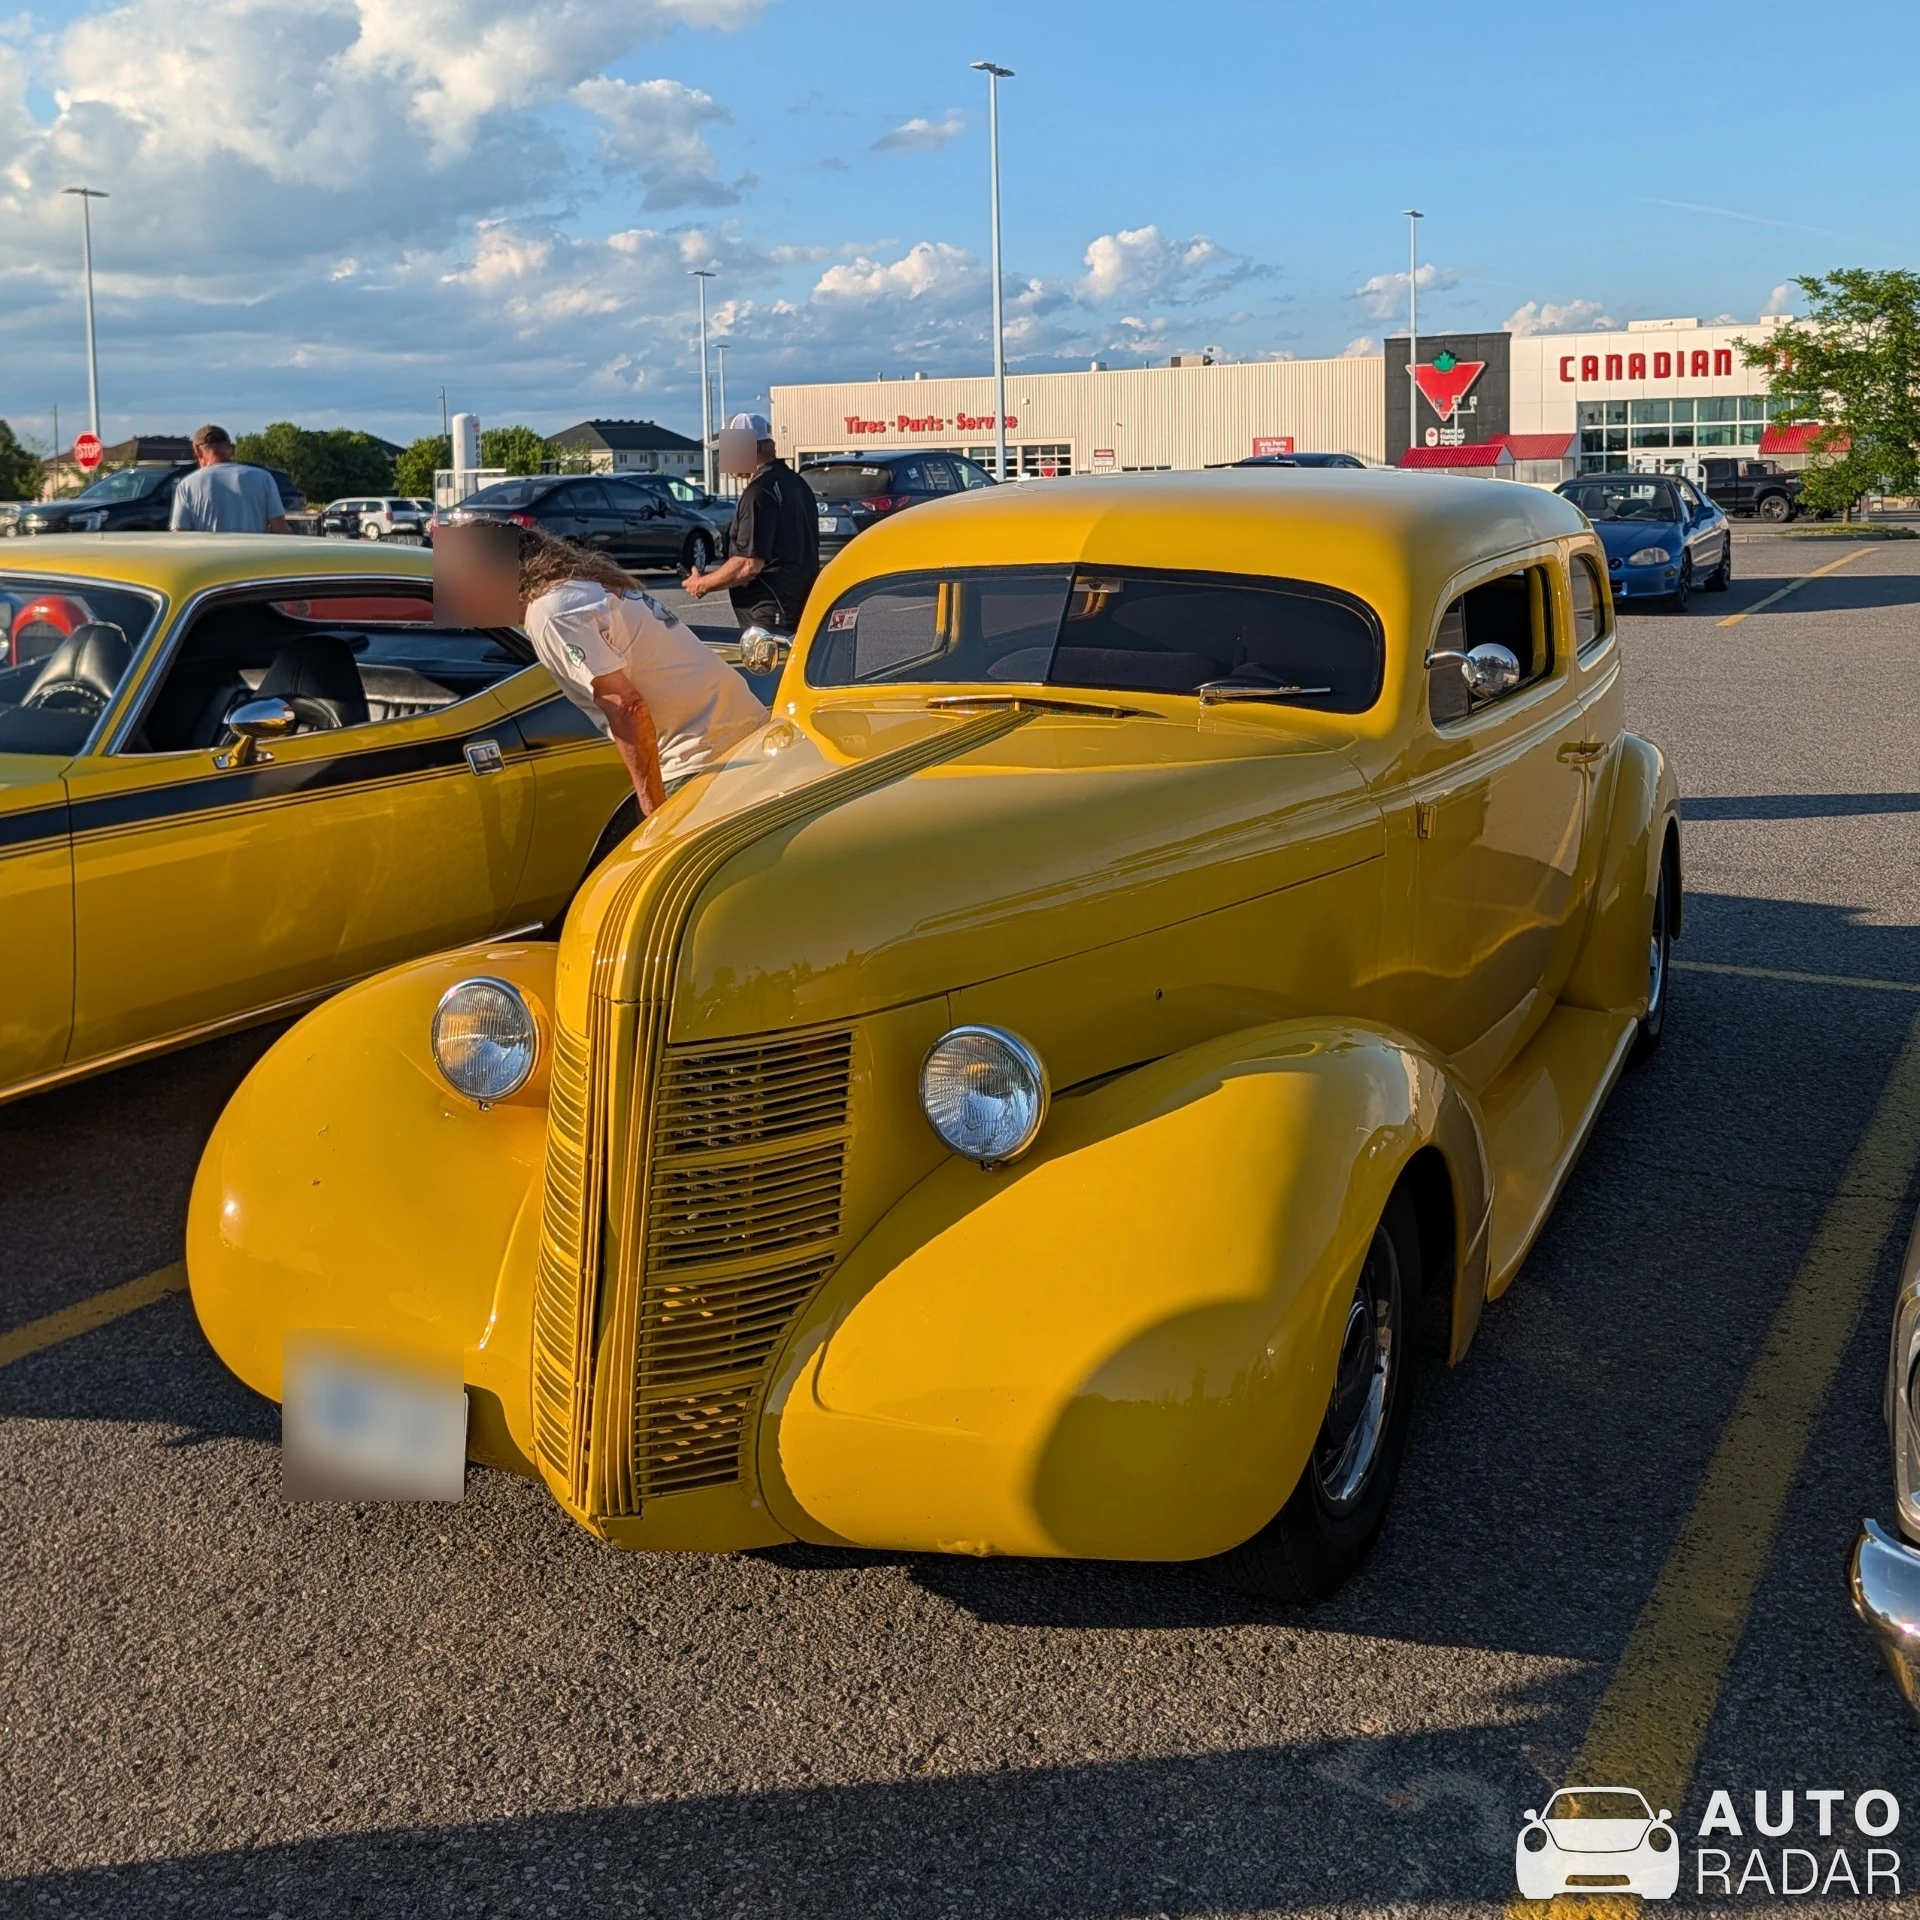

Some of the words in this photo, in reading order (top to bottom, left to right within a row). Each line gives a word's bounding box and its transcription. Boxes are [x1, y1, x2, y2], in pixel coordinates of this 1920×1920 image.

[1559, 348, 1732, 383] CANADIAN
[844, 415, 886, 434] Tires
[897, 415, 944, 433] Parts
[76, 442, 100, 459] STOP
